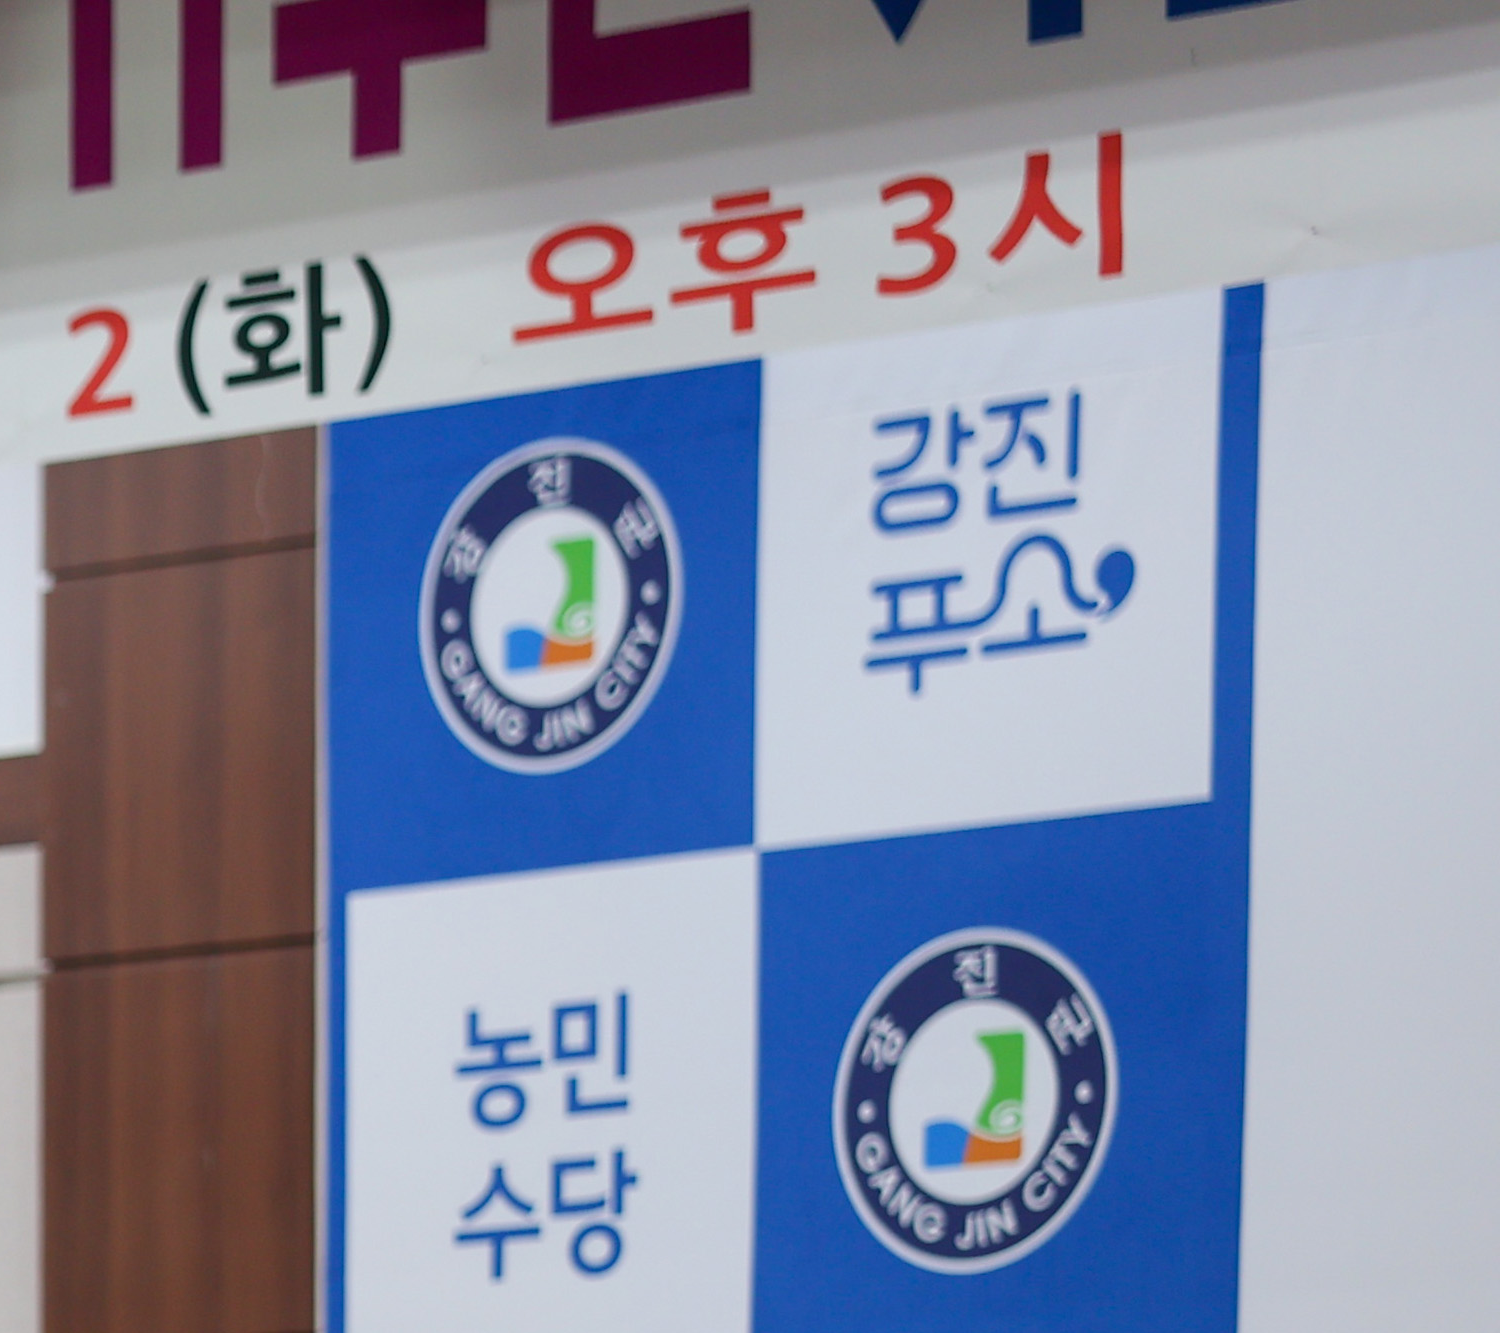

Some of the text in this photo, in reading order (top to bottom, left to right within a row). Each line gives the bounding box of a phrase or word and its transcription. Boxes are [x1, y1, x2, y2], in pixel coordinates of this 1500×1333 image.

[512, 187, 816, 343] 오후
[877, 130, 1123, 295] 3시
[872, 386, 1081, 535] 강진
[440, 609, 660, 752] GANG JIN CITY
[863, 533, 1106, 694] 푸소
[454, 990, 634, 1130] 농민
[454, 1147, 638, 1281] 수당
[855, 1111, 1093, 1252] GANG JIN CITY
